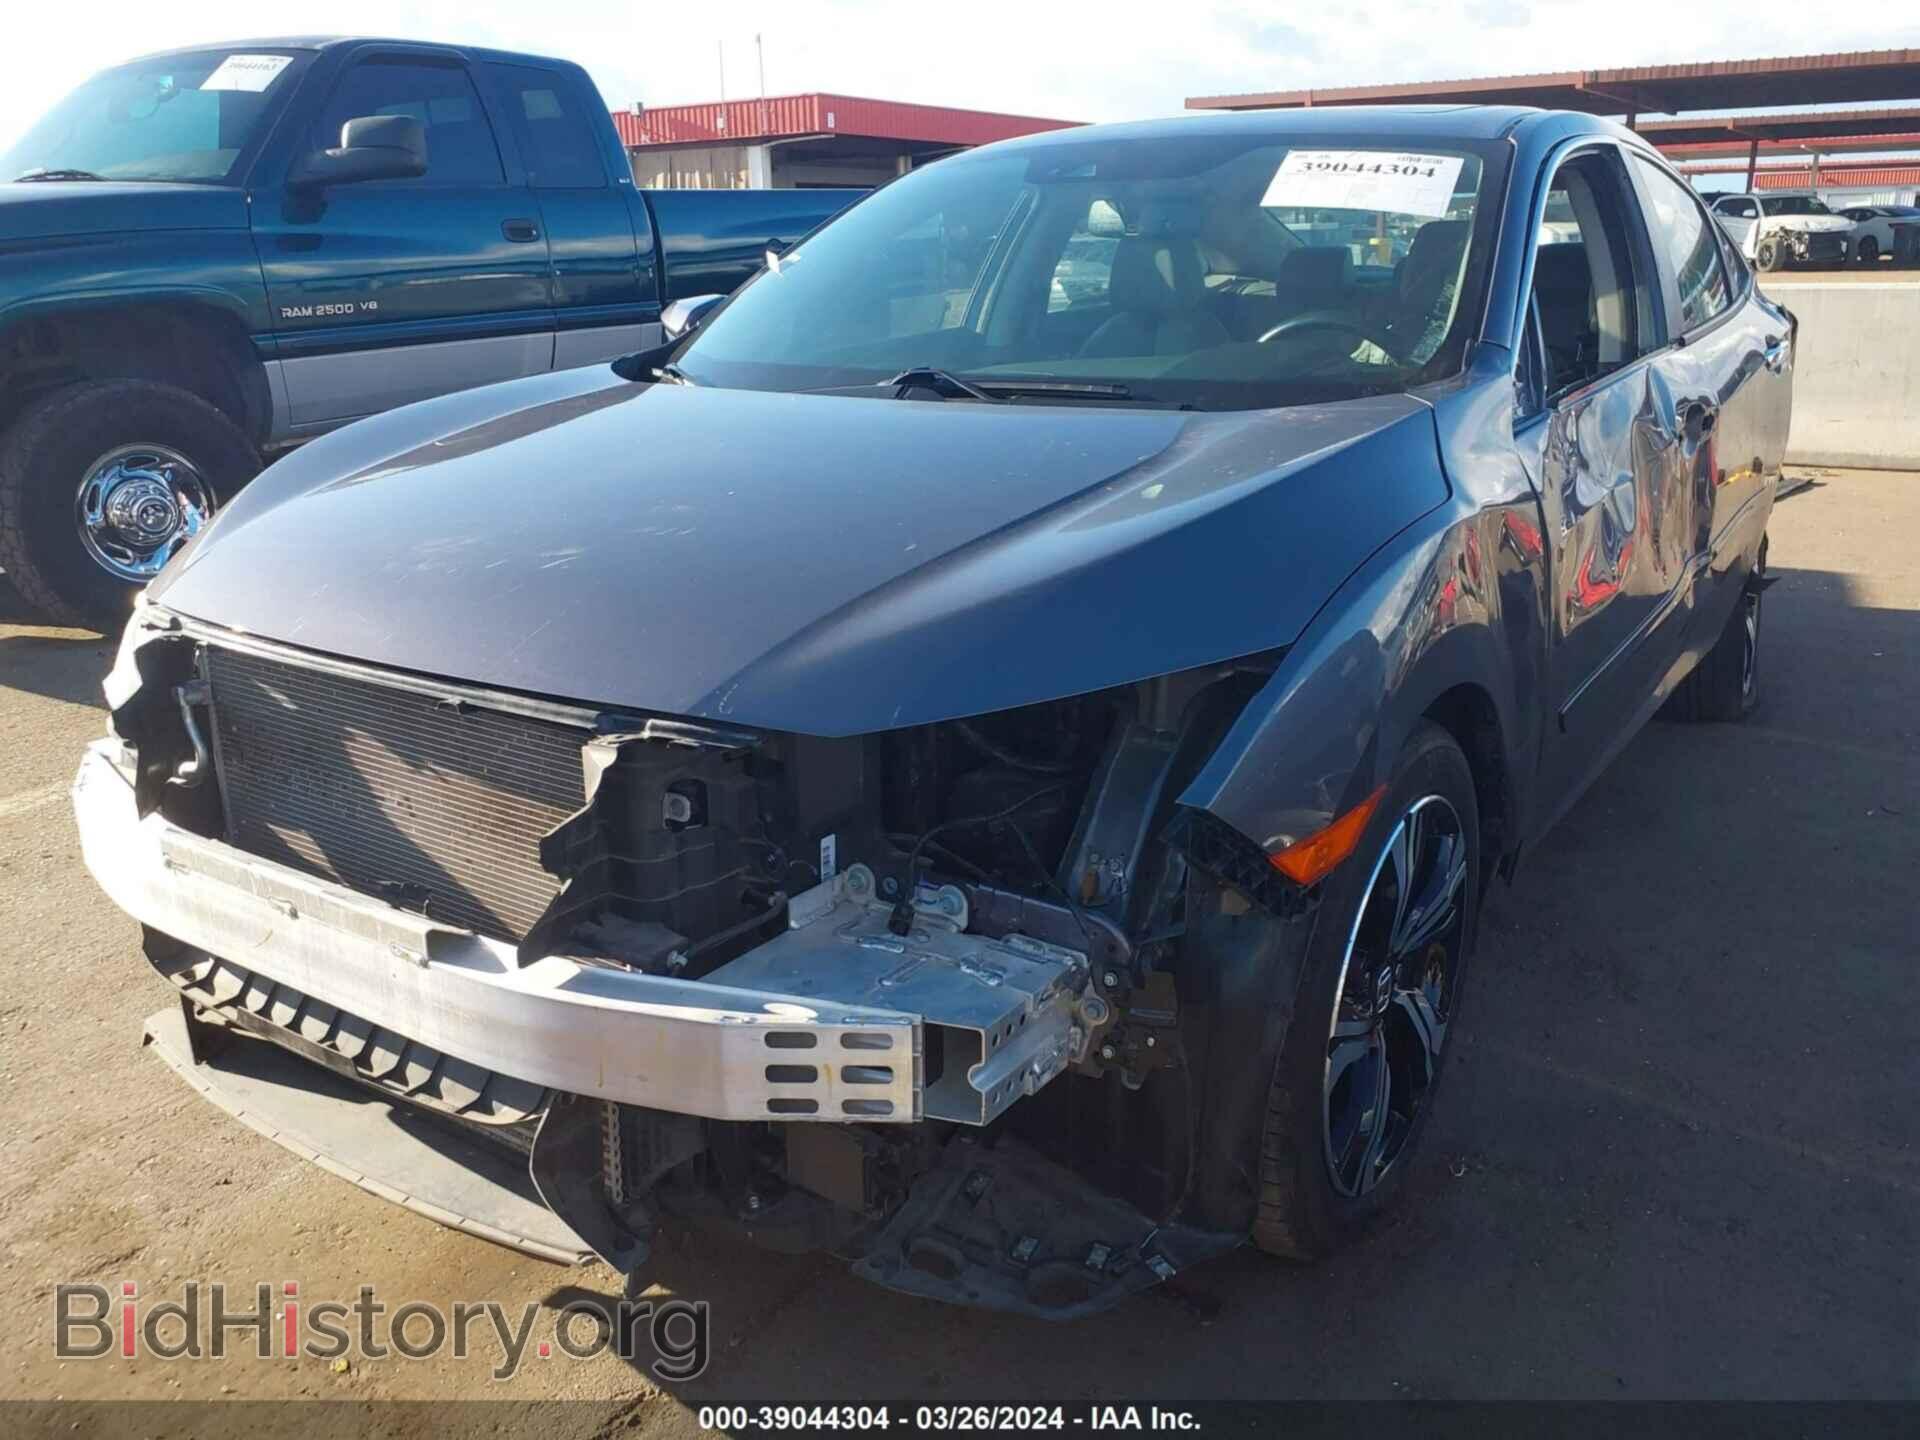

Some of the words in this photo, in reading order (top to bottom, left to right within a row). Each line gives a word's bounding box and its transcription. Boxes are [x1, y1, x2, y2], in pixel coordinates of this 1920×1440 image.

[1297, 160, 1436, 178] 39044304
[281, 306, 313, 318] RAM
[316, 303, 354, 316] 2500
[360, 301, 378, 310] V8
